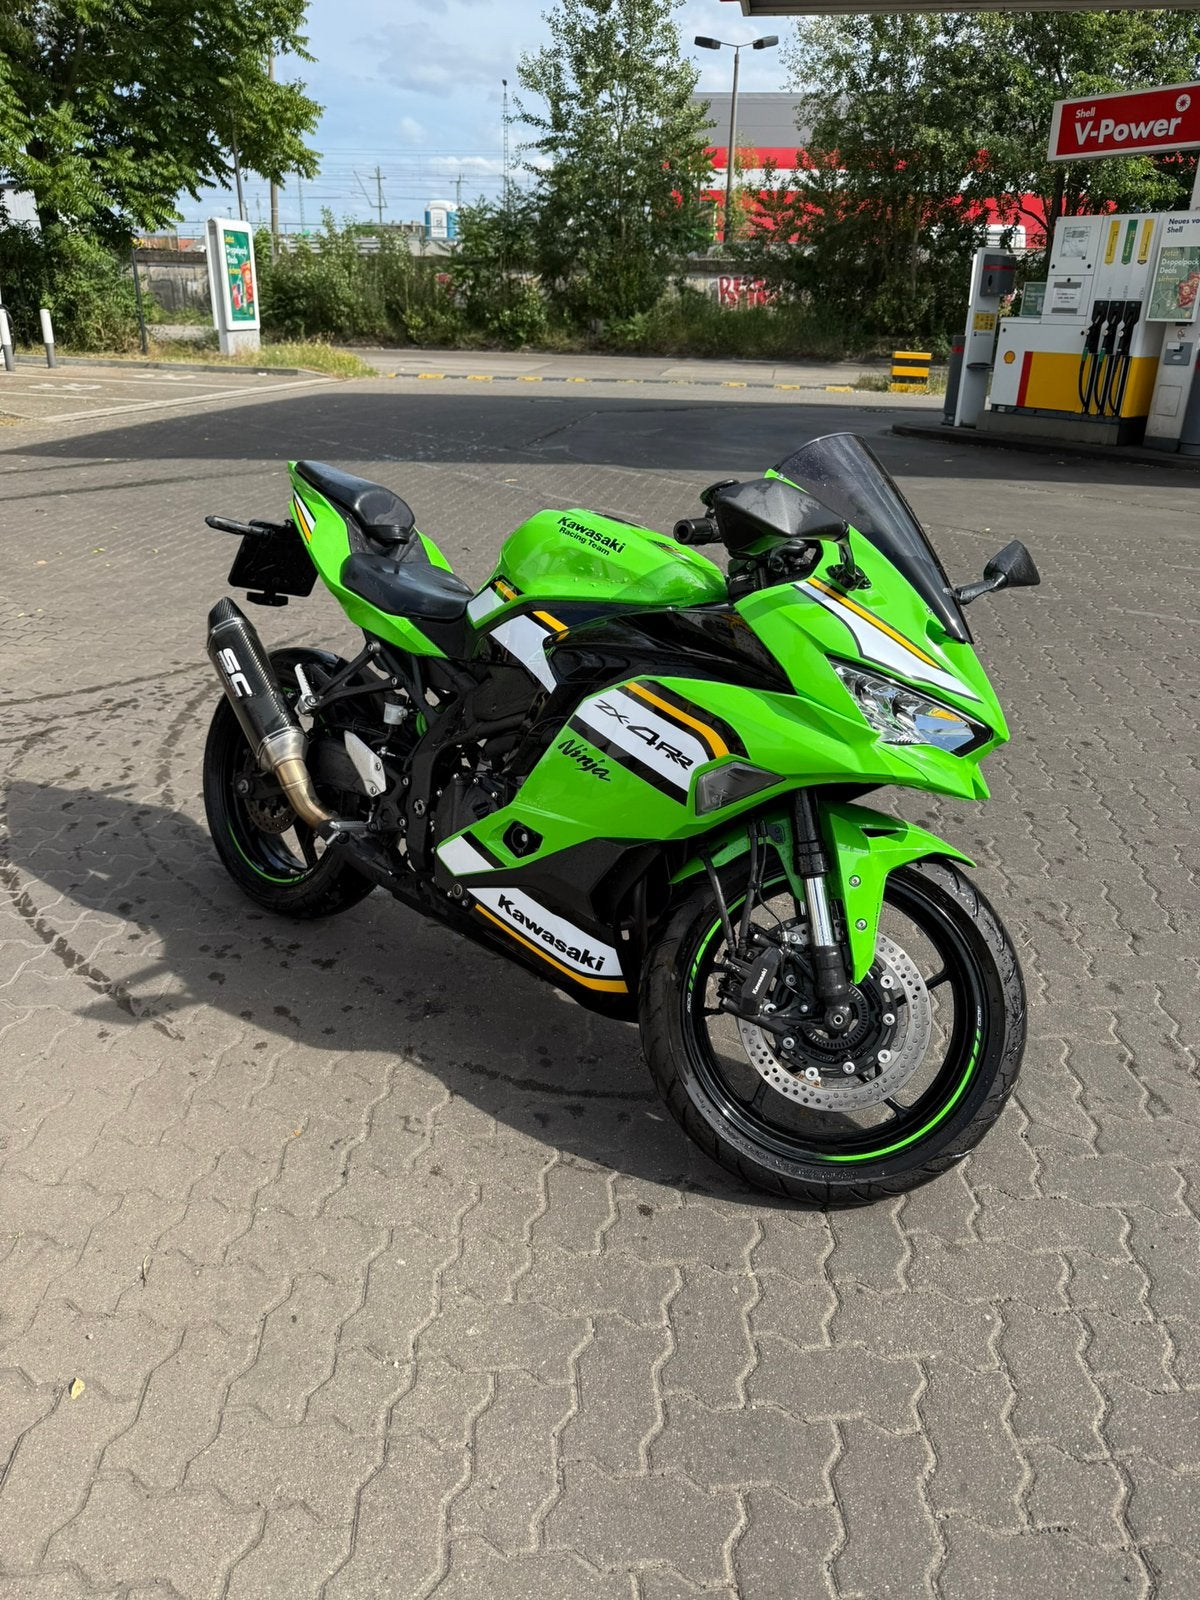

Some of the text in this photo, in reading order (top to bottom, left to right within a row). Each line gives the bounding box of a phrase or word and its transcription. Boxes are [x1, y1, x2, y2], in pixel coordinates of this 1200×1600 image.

[1075, 106, 1096, 119] Shell
[1074, 117, 1183, 146] V-Power
[1166, 226, 1184, 234] Shell
[1168, 218, 1190, 226] Neues
[557, 516, 627, 553] Kawasaki
[558, 526, 610, 556] Racing Team
[217, 647, 253, 697] SC
[557, 738, 611, 782] Ninja
[497, 893, 606, 972] Kawasaki
